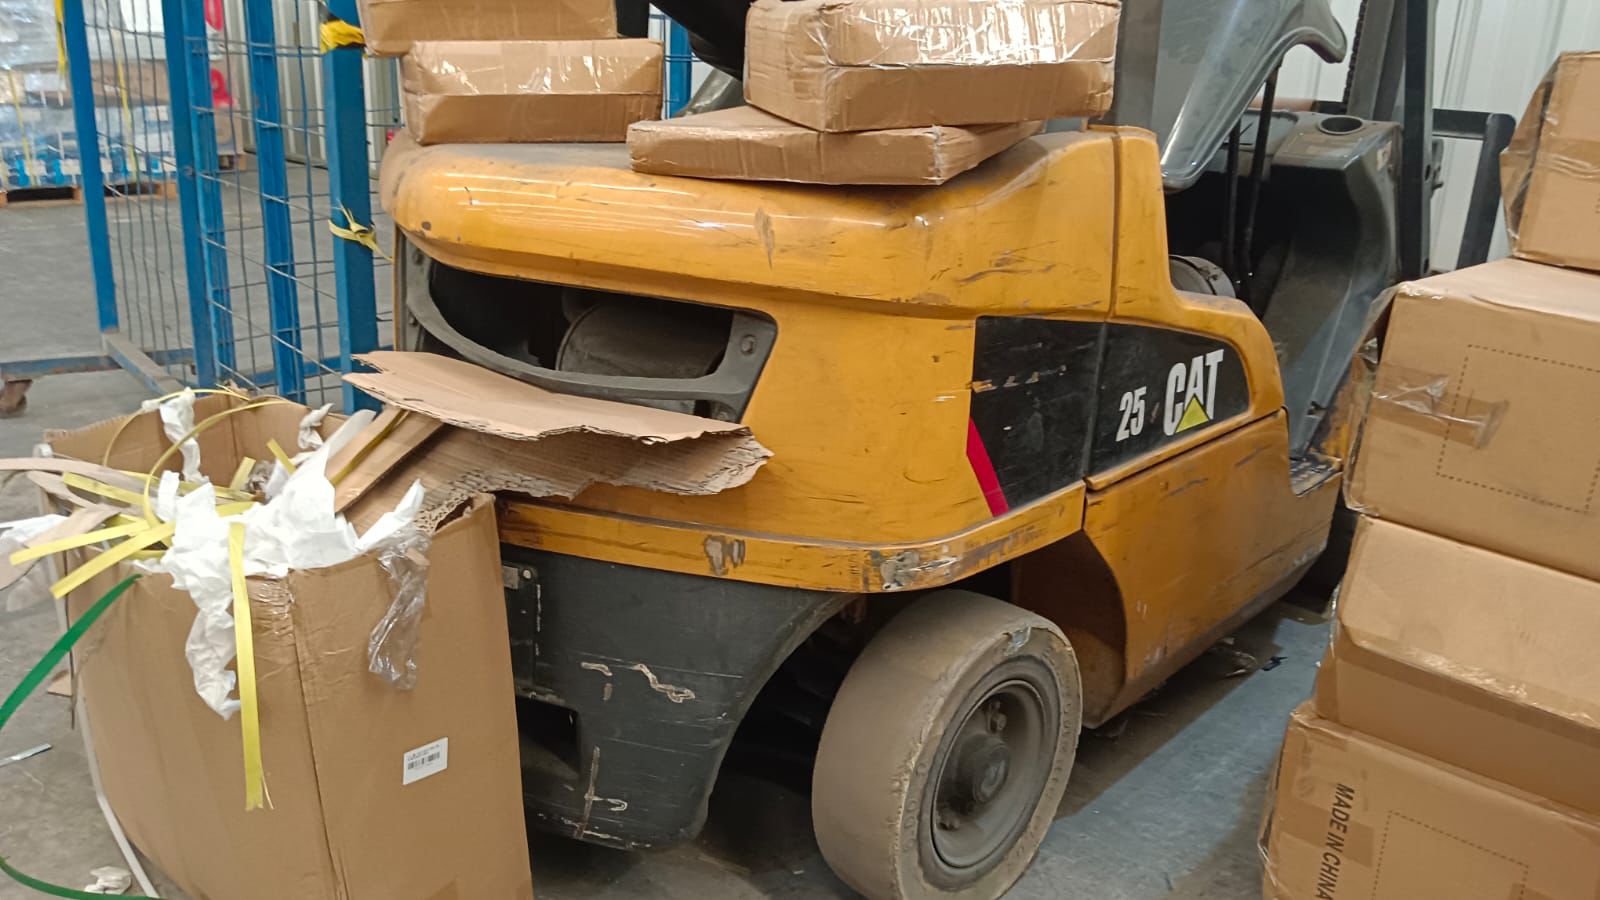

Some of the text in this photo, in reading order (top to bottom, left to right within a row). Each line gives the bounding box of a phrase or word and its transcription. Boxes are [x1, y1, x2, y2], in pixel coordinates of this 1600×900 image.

[1116, 386, 1147, 442] 25
[1163, 349, 1224, 436] CAT
[1315, 783, 1355, 900] MADE IN CHINA
